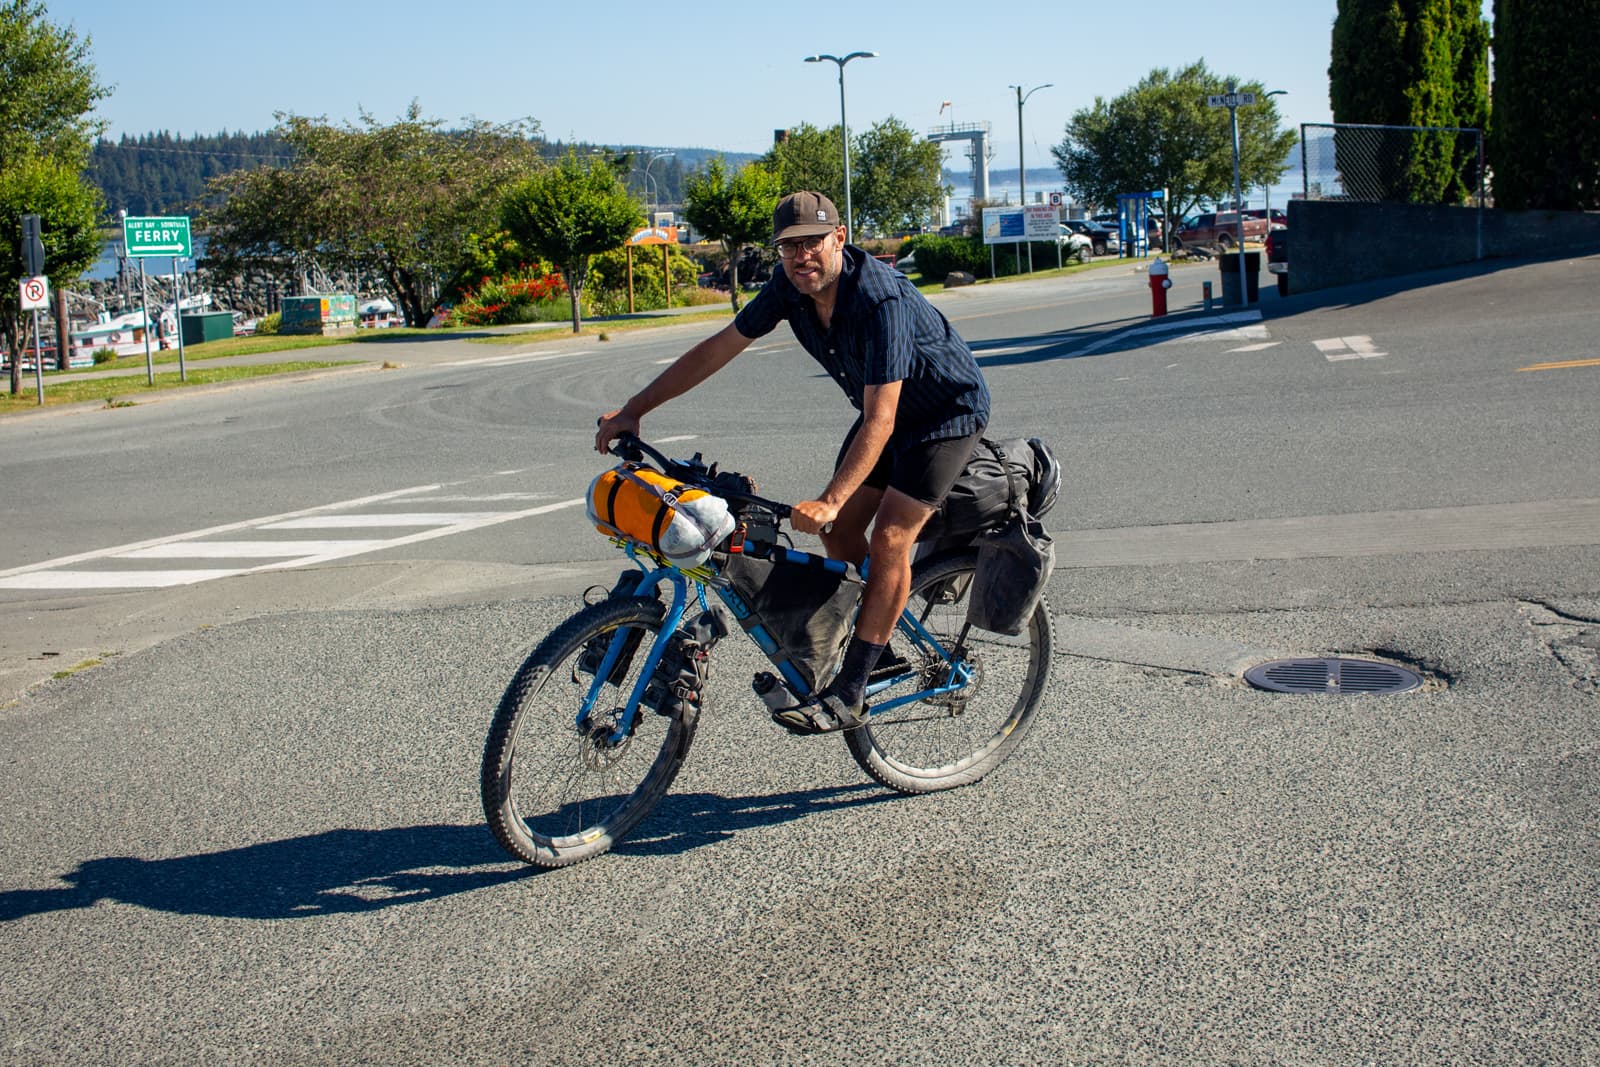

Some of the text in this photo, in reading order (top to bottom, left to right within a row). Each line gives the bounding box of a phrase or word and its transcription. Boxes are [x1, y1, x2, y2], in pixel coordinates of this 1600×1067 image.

[1243, 94, 1253, 104] RD
[128, 221, 143, 229] ALERT
[135, 229, 180, 242] FERRY
